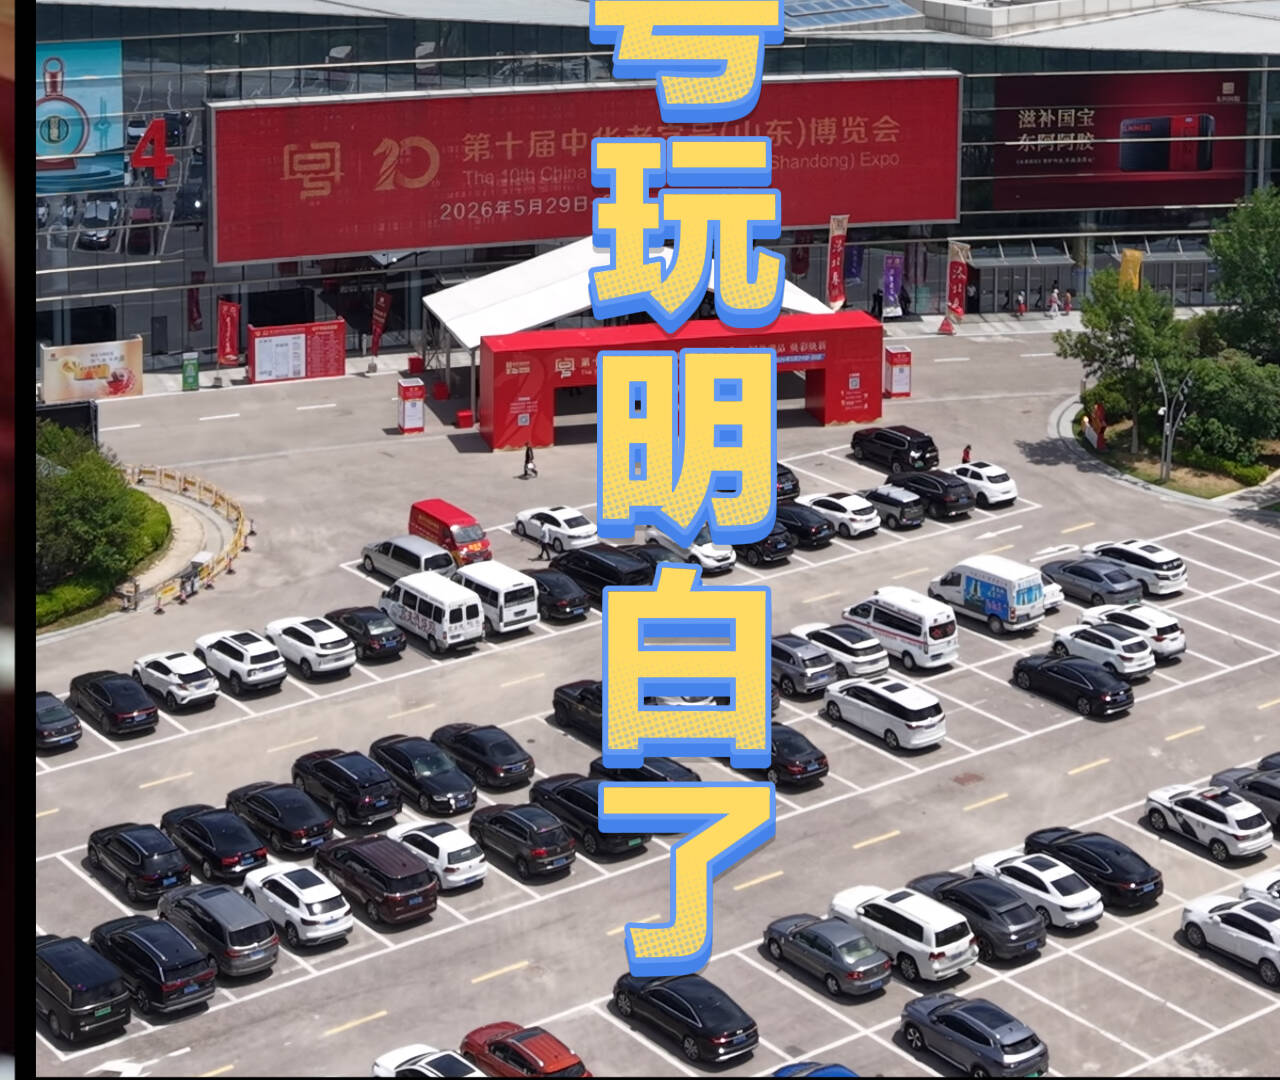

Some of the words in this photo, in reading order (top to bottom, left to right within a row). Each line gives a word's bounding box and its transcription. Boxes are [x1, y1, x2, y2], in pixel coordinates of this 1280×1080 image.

[1017, 108, 1096, 130] 滋补国宝
[131, 117, 176, 180] 4
[1016, 131, 1096, 153] 东阿阿胶
[462, 169, 495, 187] The
[541, 164, 588, 182] China
[860, 151, 900, 172] Expo
